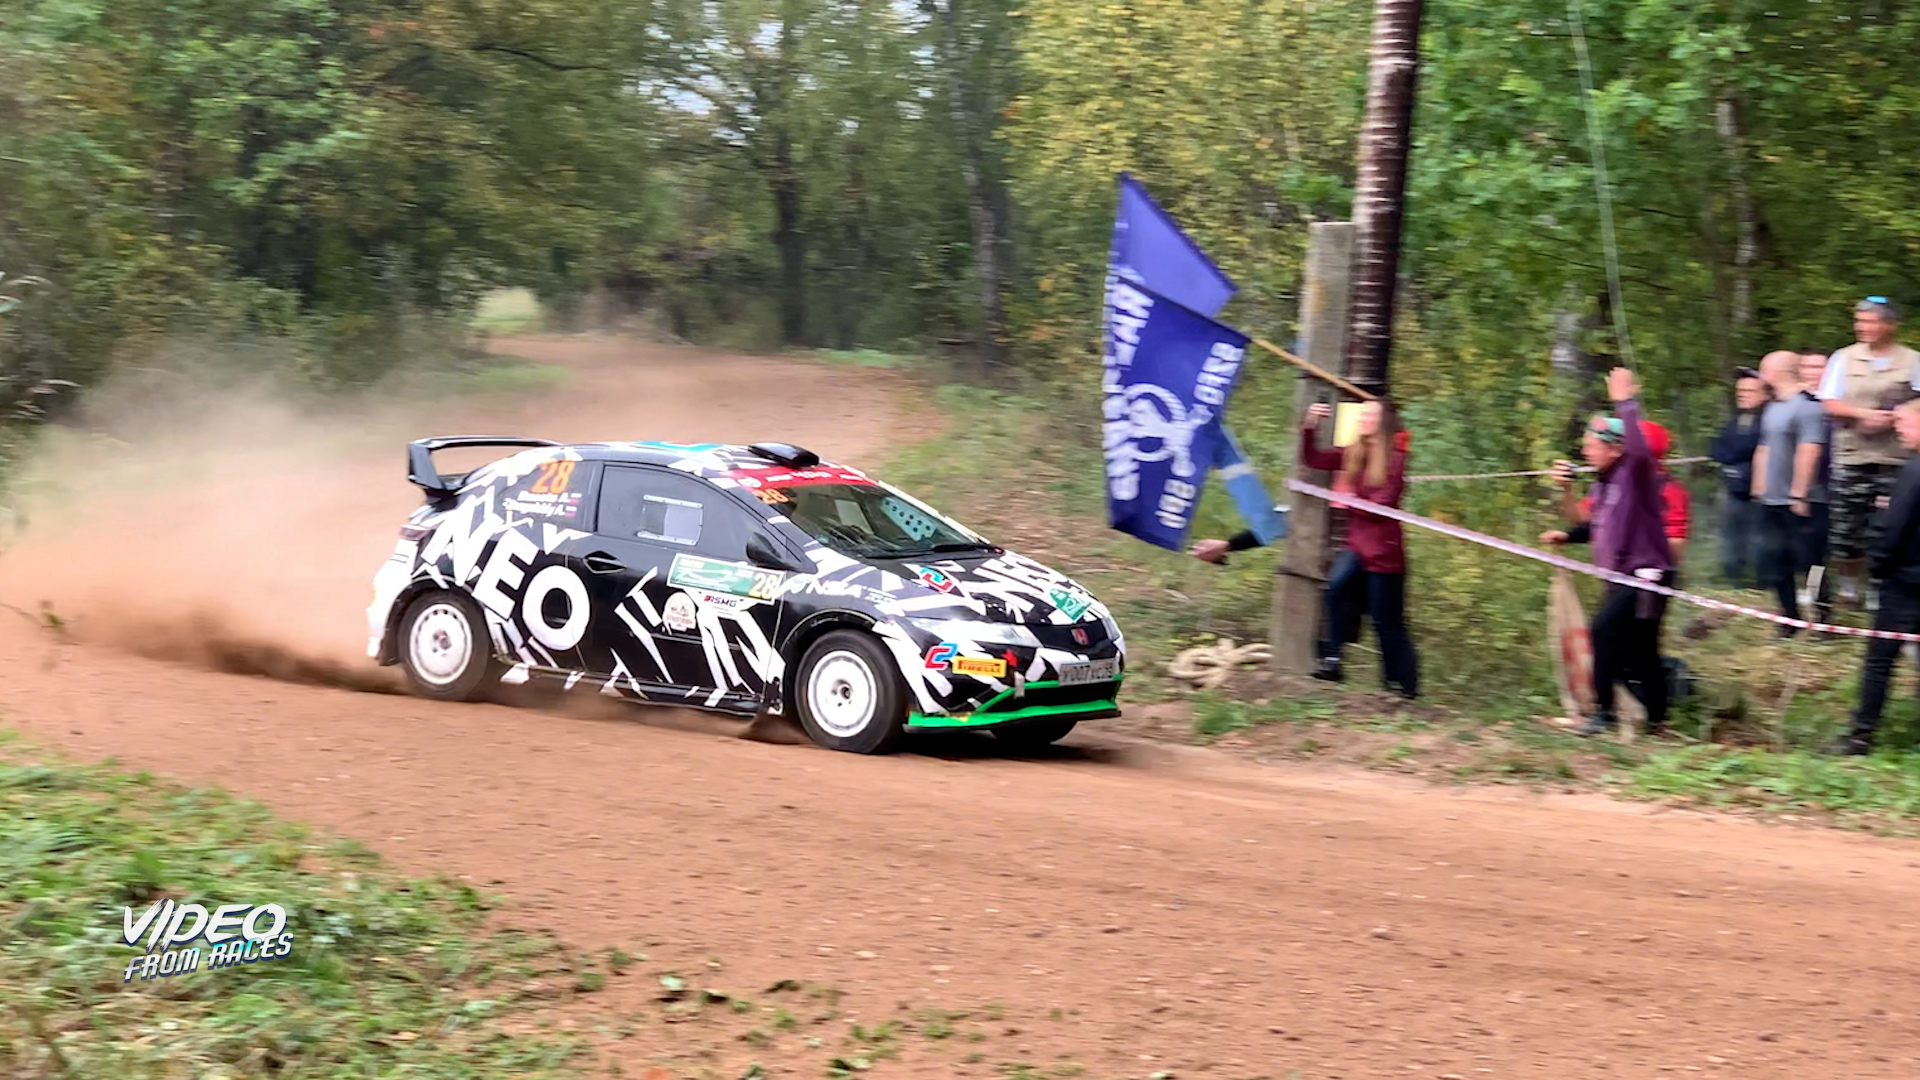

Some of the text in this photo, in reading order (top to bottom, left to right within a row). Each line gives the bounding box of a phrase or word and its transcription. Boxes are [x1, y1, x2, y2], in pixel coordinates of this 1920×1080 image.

[530, 460, 576, 493] 28
[752, 488, 789, 505] 28
[421, 489, 591, 651] NEO
[749, 572, 777, 599] 28
[958, 660, 1001, 674] PIRELLI
